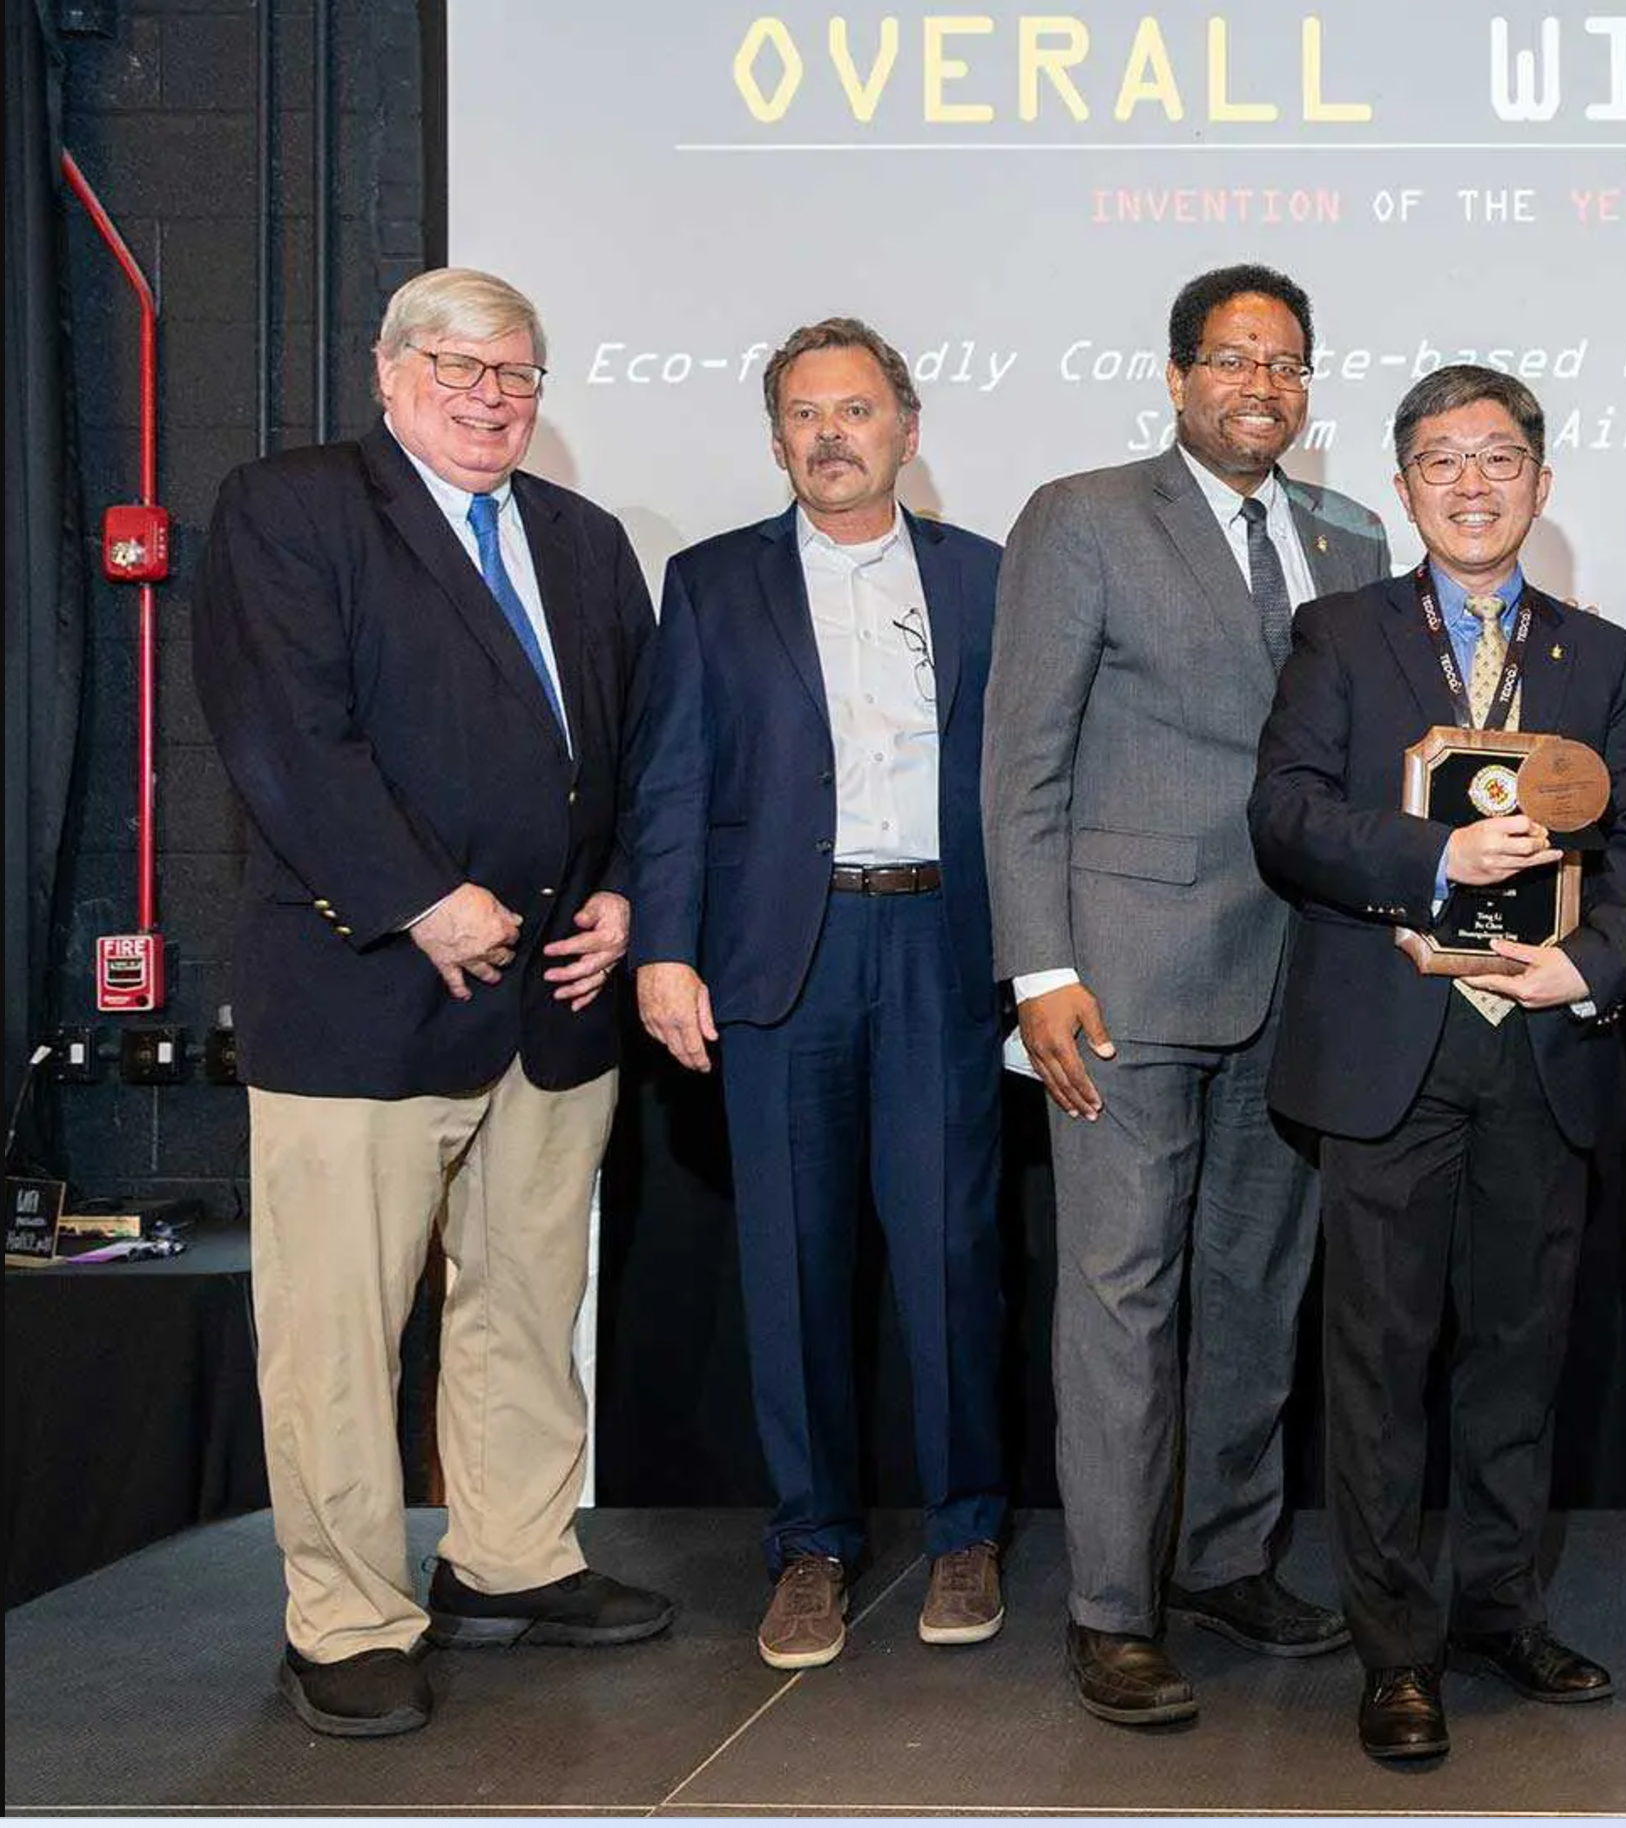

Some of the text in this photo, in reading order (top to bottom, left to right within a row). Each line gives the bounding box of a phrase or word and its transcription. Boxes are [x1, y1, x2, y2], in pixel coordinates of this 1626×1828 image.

[734, 16, 1372, 122] OVERALL
[1091, 190, 1341, 223] INVENTION
[1373, 190, 1422, 222] OF
[1458, 190, 1536, 222] THE
[1439, 653, 1462, 694] TEDCO
[1499, 664, 1518, 703] TEDCO
[104, 940, 146, 957] FIRE
